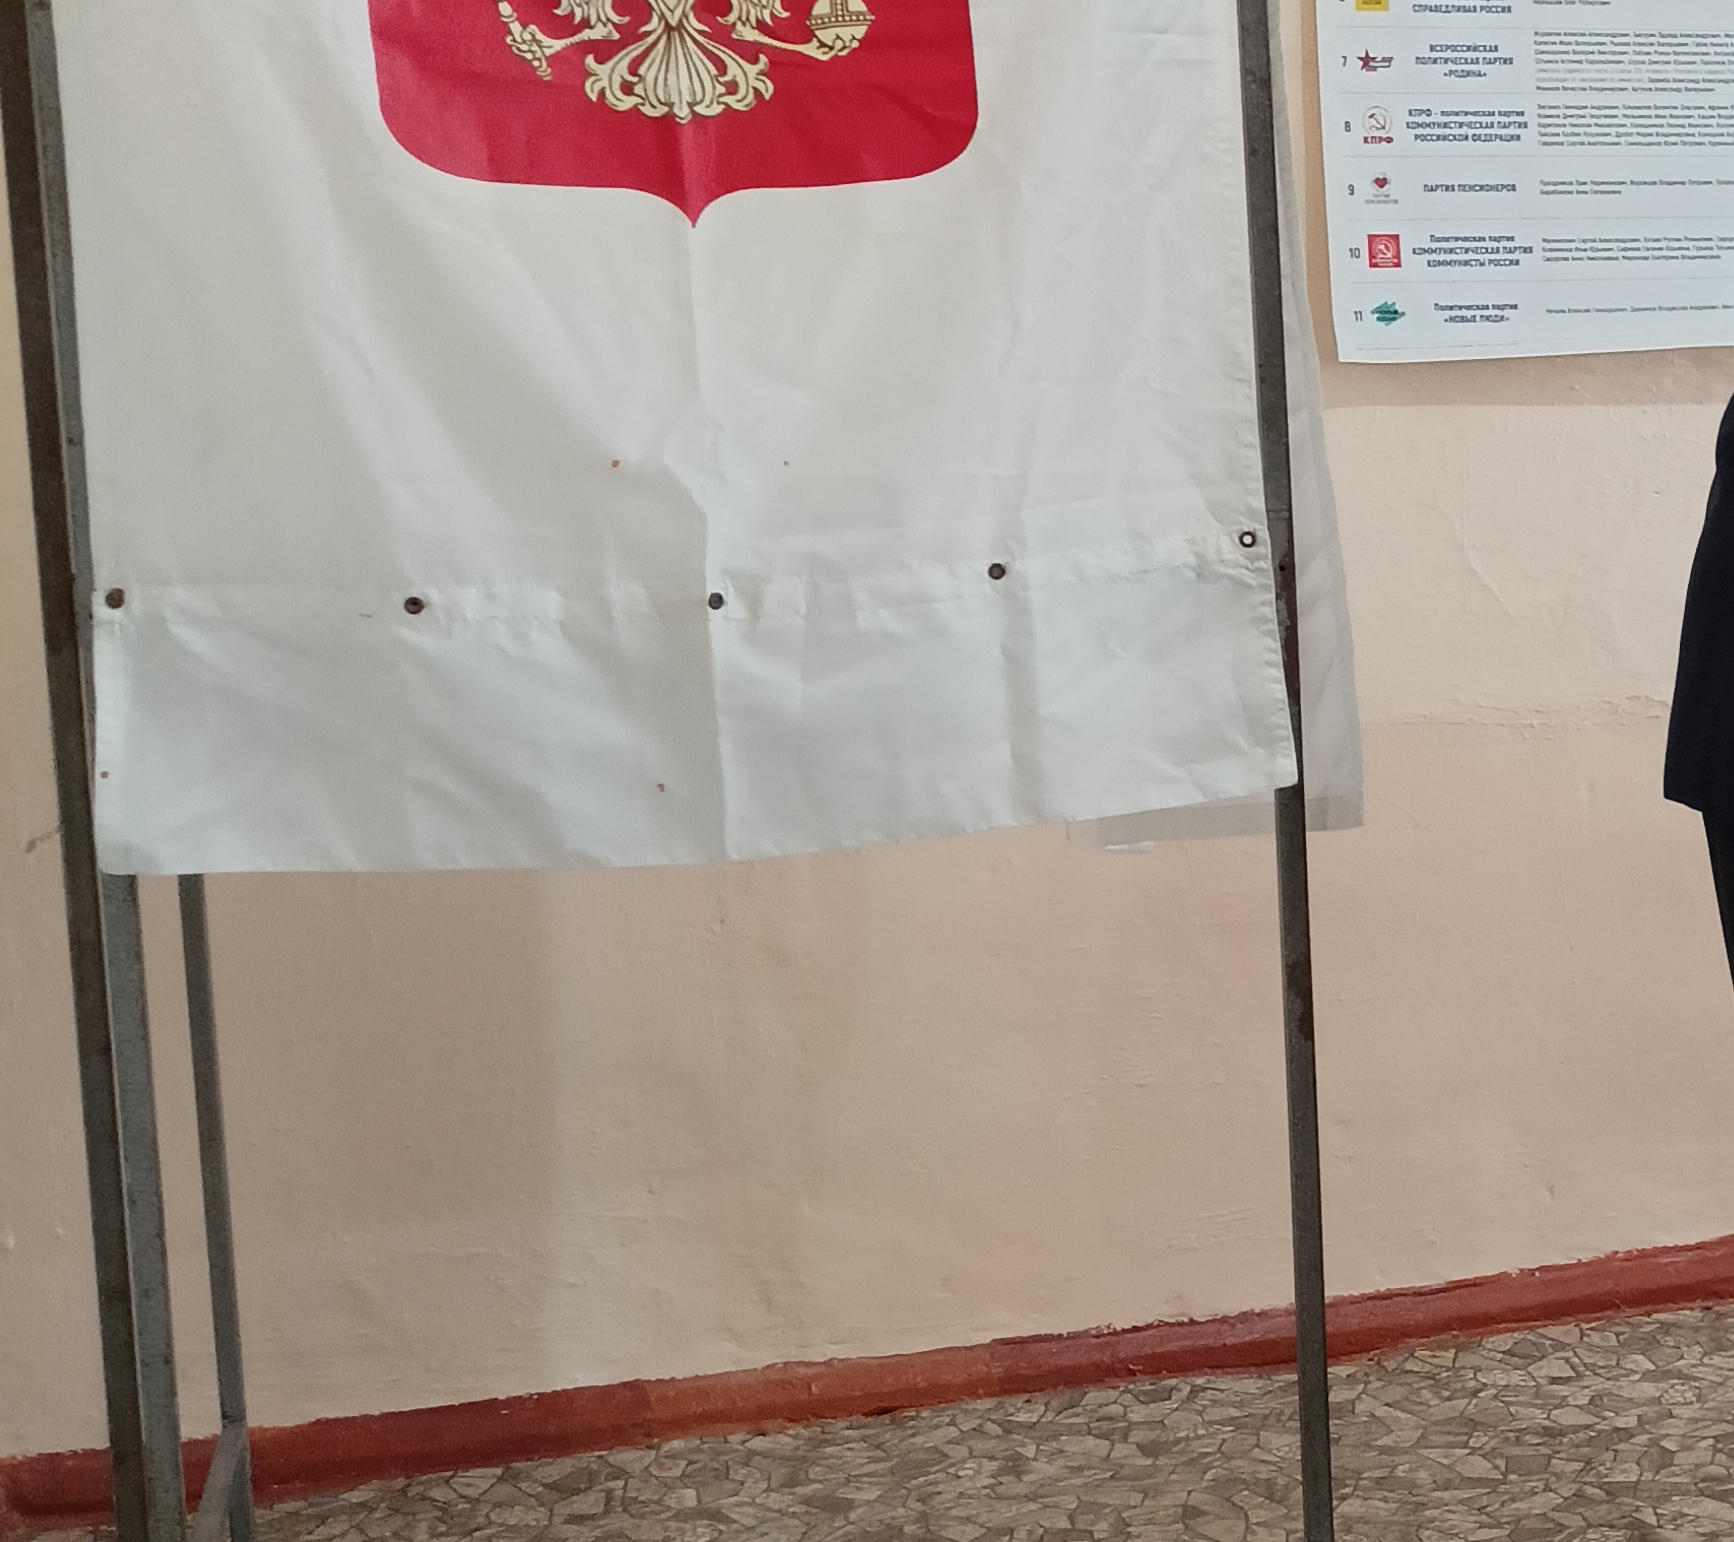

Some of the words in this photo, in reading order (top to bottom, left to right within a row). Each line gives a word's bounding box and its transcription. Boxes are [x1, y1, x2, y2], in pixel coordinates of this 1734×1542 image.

[1341, 55, 1348, 67] 7
[1344, 121, 1351, 132] 8
[1363, 135, 1394, 144] КПРФ
[1348, 184, 1355, 195] 9
[1349, 247, 1361, 259] 10
[1354, 310, 1363, 322] 11
